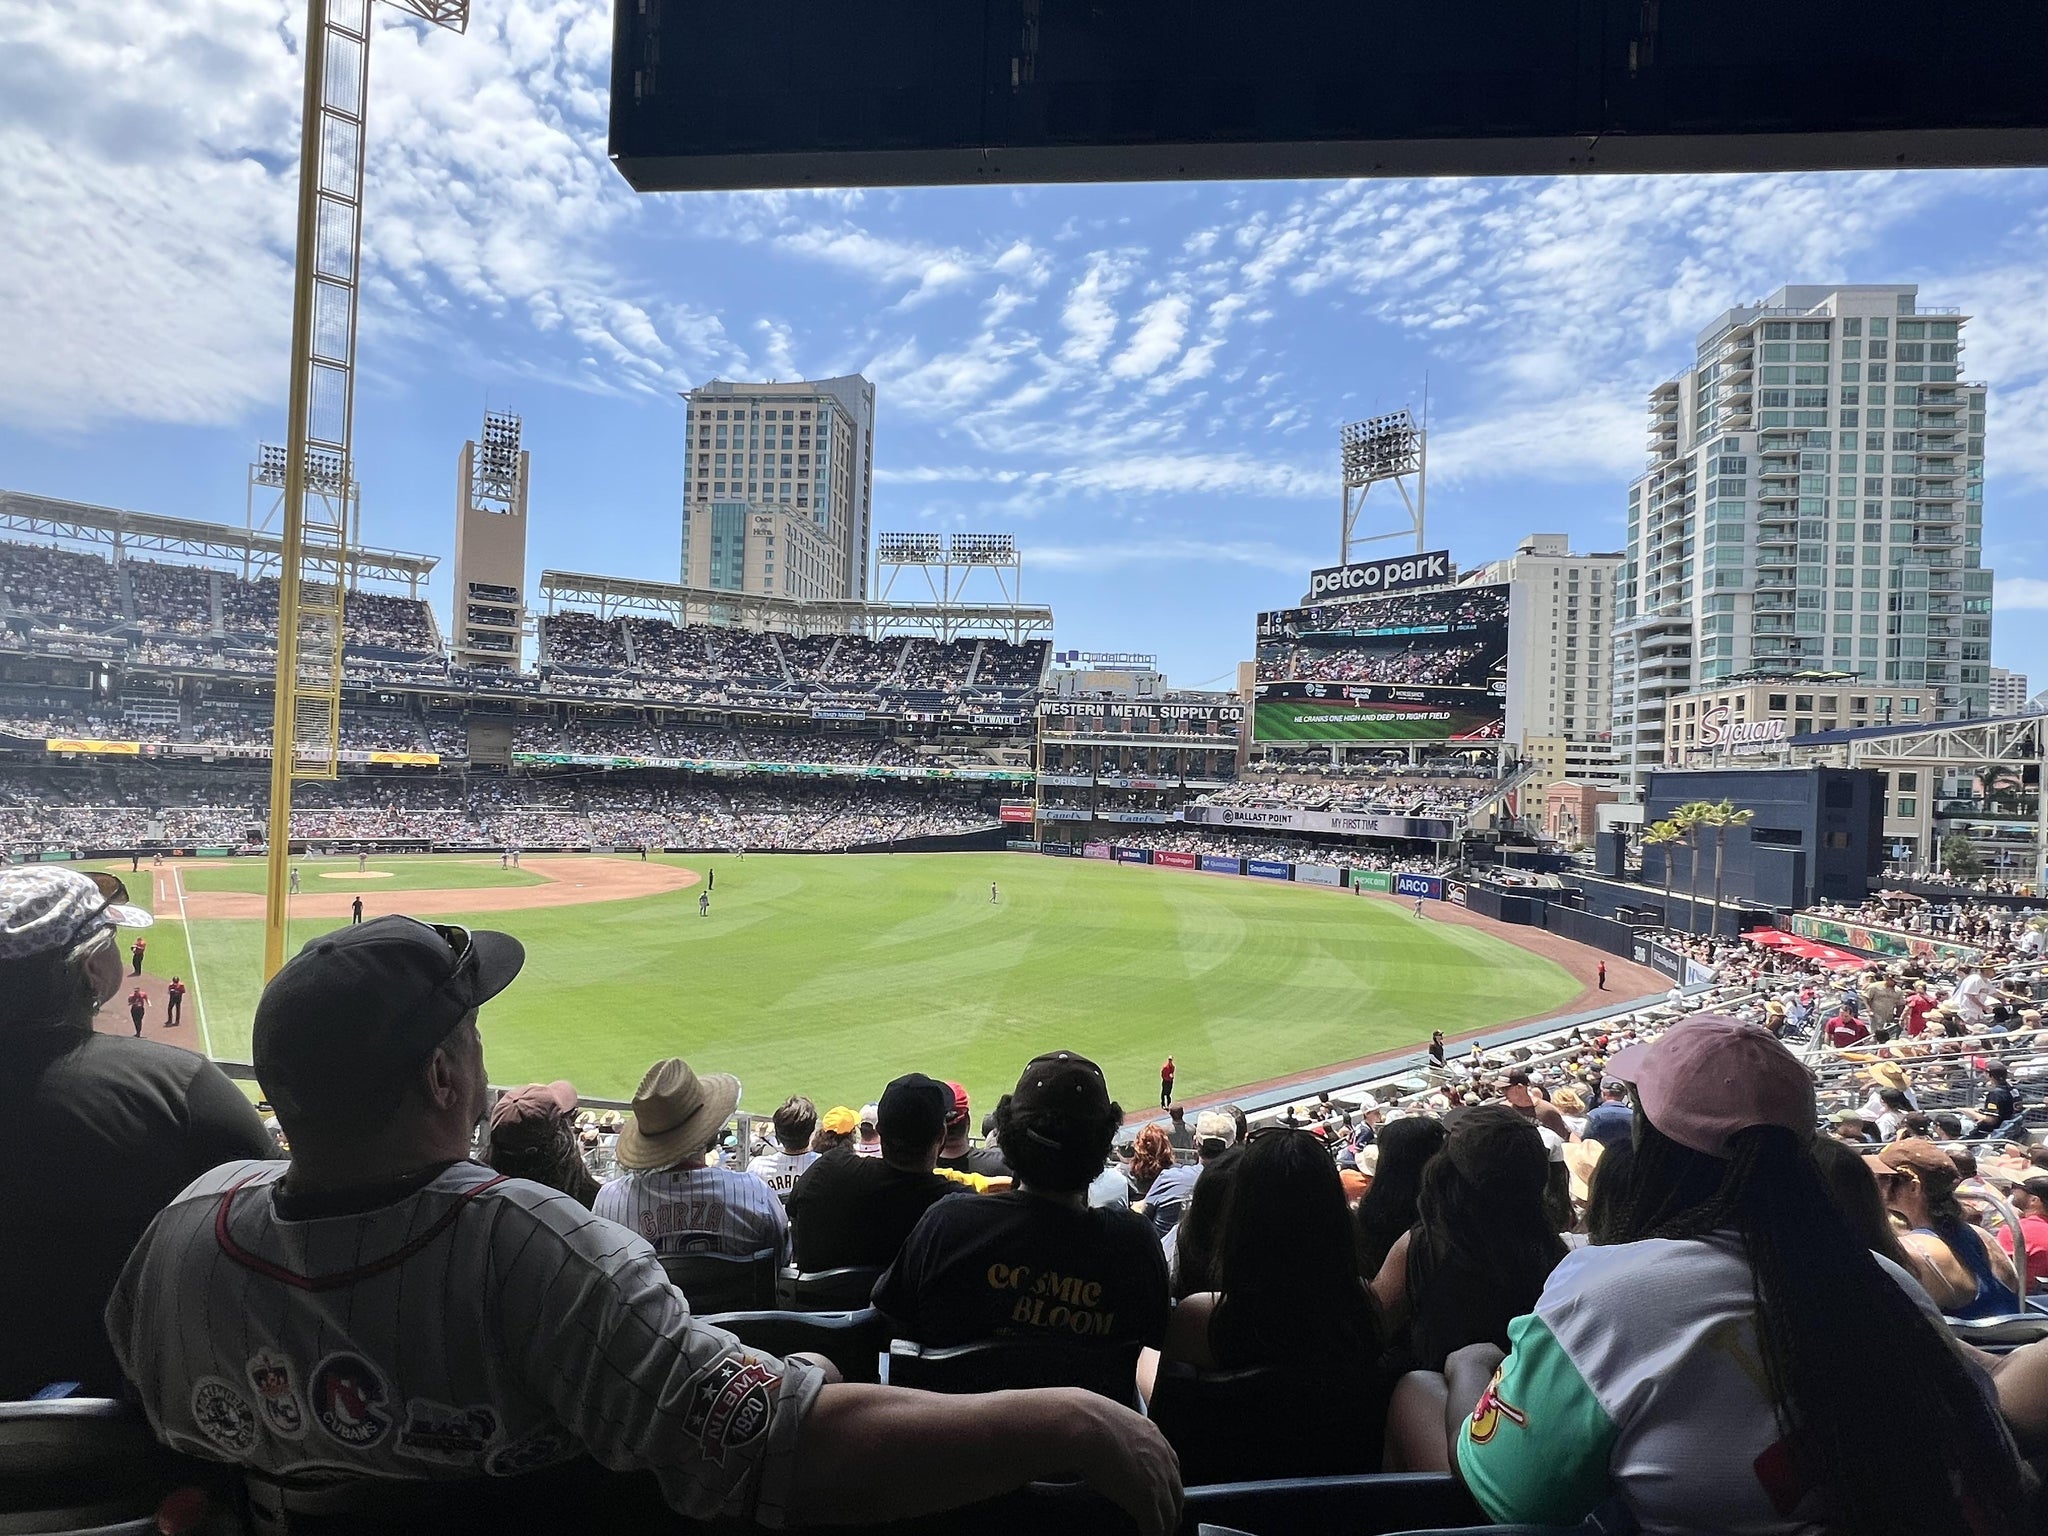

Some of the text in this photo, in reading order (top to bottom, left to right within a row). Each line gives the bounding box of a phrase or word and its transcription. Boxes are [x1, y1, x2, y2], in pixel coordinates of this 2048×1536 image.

[1311, 555, 1445, 599] petco park
[1082, 652, 1151, 663] QuidelOrtho
[1040, 703, 1243, 721] WESTERN METAL SUPPLY CO.
[1303, 715, 1328, 723] CRANKS
[1377, 713, 1395, 721] DEEP
[1406, 712, 1428, 720] RIGHT
[1428, 711, 1450, 720] FIELD
[1699, 705, 1785, 755] Sycuan
[645, 759, 680, 768] THE PIER
[895, 768, 927, 777] THE PIER
[1052, 777, 1078, 786] ORIS
[1235, 812, 1292, 823] BALLAST POINT
[1331, 818, 1378, 831] MY FIRST TIME
[1164, 855, 1193, 866] Snapdragon
[1249, 864, 1281, 875] Southwest
[1399, 878, 1429, 893] ARCO
[640, 1202, 725, 1238] GARZA
[1010, 1296, 1115, 1336] BLOOM
[708, 1373, 754, 1440] NLBM
[731, 1396, 765, 1438] 1920
[322, 1411, 379, 1441] CUBANS
